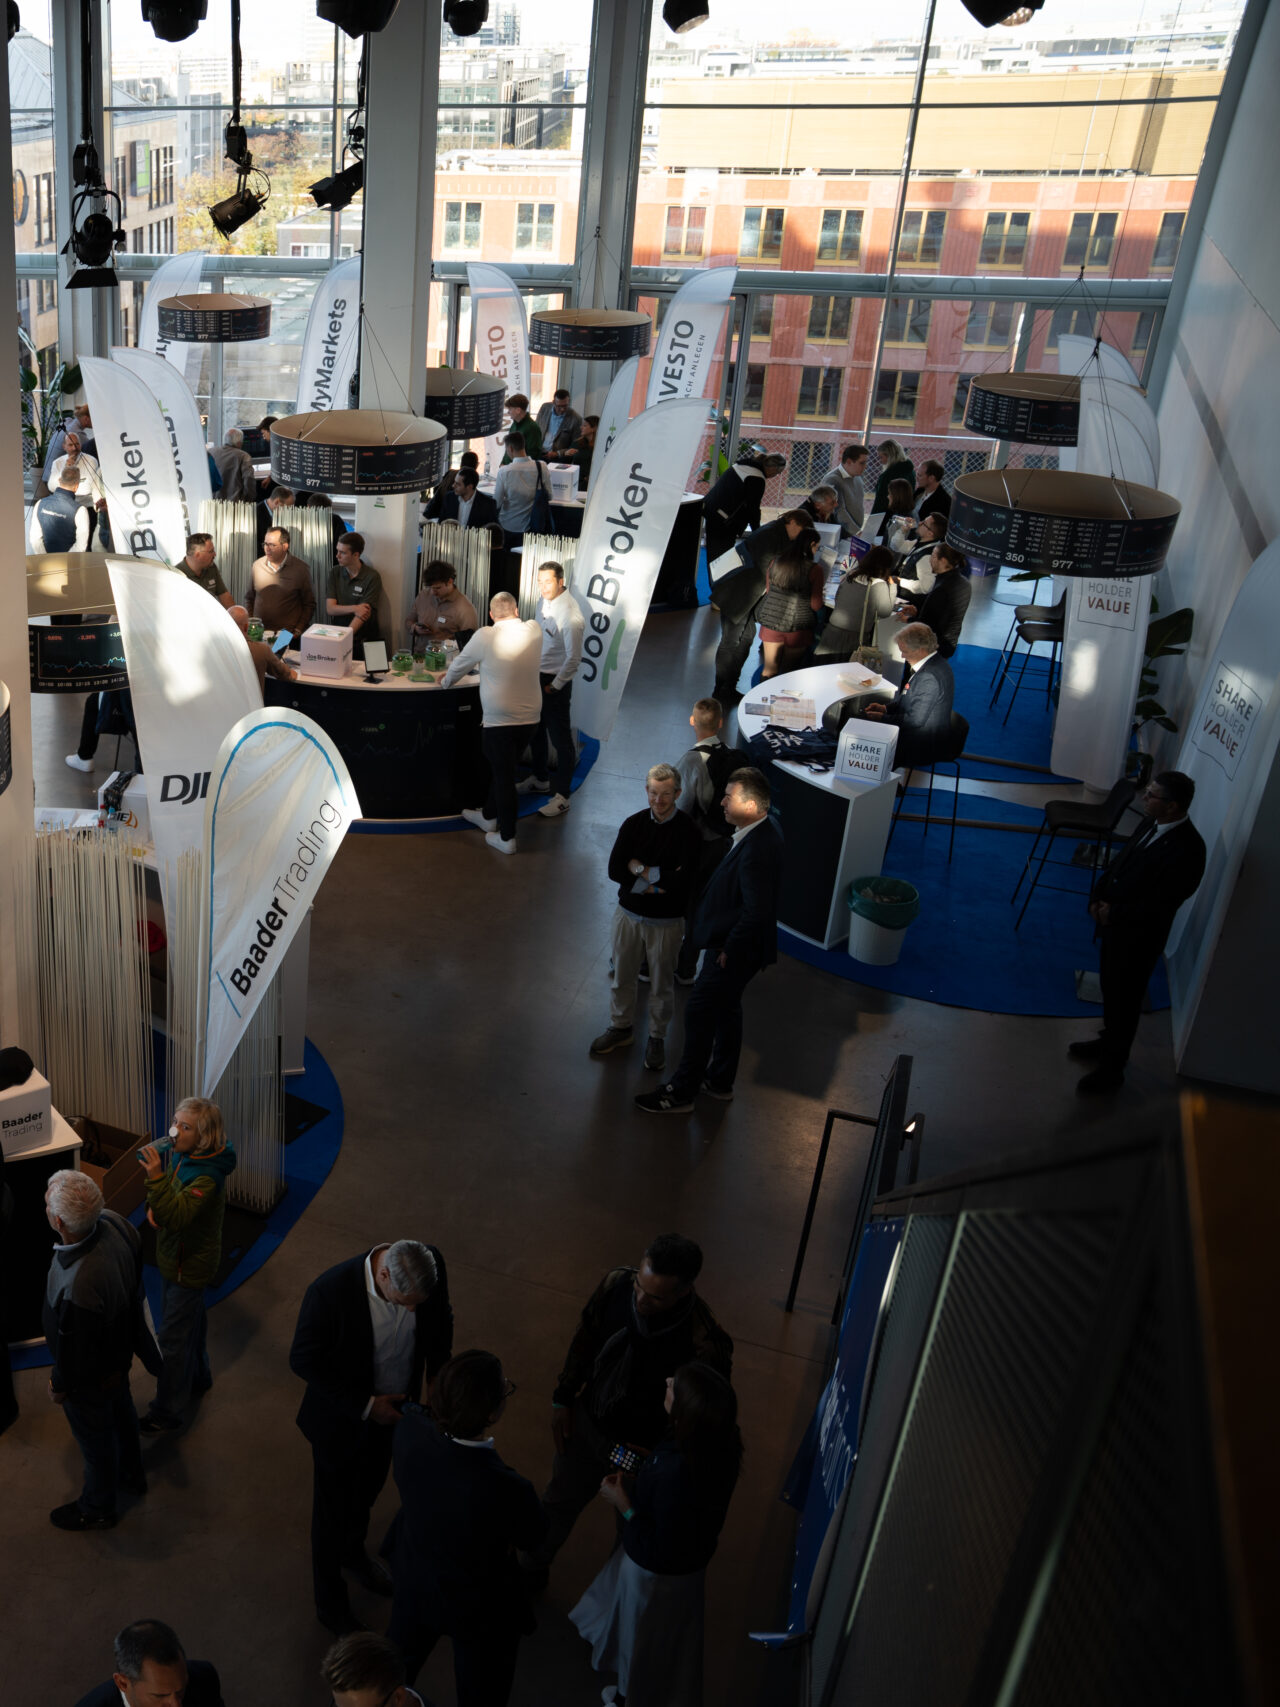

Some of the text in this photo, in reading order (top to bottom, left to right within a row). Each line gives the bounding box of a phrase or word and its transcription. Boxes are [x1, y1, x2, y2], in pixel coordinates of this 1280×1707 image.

[659, 320, 694, 399] VESTO
[692, 335, 706, 377] ANLEGEN
[452, 428, 466, 436] 350
[984, 424, 997, 432] 977
[281, 473, 291, 482] 350
[306, 479, 320, 487] 977
[120, 432, 157, 552] Broker
[1005, 552, 1024, 563] 350
[1051, 559, 1074, 569] 977
[1088, 582, 1132, 598] HOLDER
[1087, 596, 1131, 615] VALUE
[1215, 679, 1254, 722] SHARE
[1209, 699, 1246, 738] HOLDER
[1202, 715, 1239, 759] VALUE
[849, 751, 880, 763] HOLDER
[850, 742, 882, 756] SHARE
[848, 759, 879, 772] VALUE
[230, 800, 342, 996] Baader Trading
[2, 1112, 43, 1129] Baader
[3, 1122, 43, 1139] Trading
